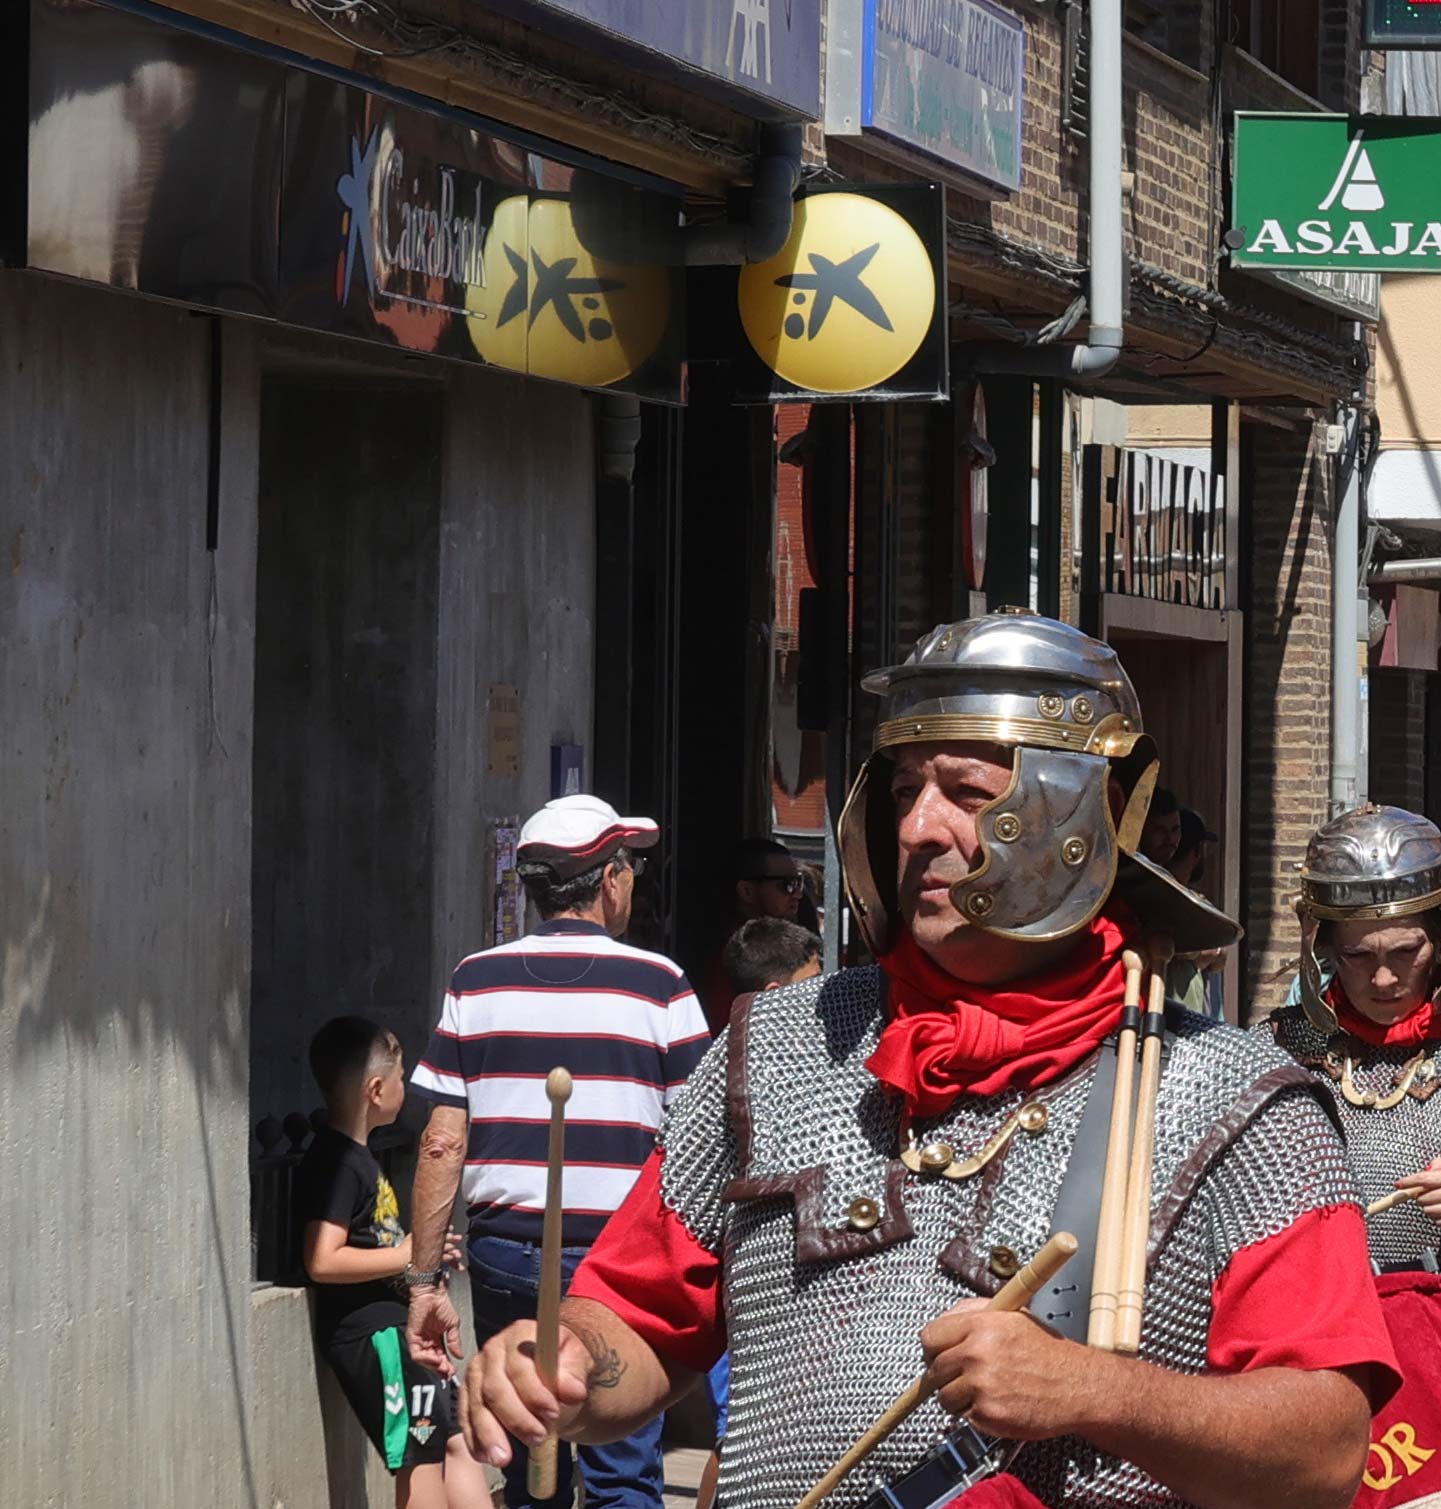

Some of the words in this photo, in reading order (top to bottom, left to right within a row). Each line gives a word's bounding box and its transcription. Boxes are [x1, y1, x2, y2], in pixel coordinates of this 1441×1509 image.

[382, 148, 488, 290] CaixaBank
[1100, 444, 1226, 611] FARMACIA
[411, 1384, 436, 1417] 17
